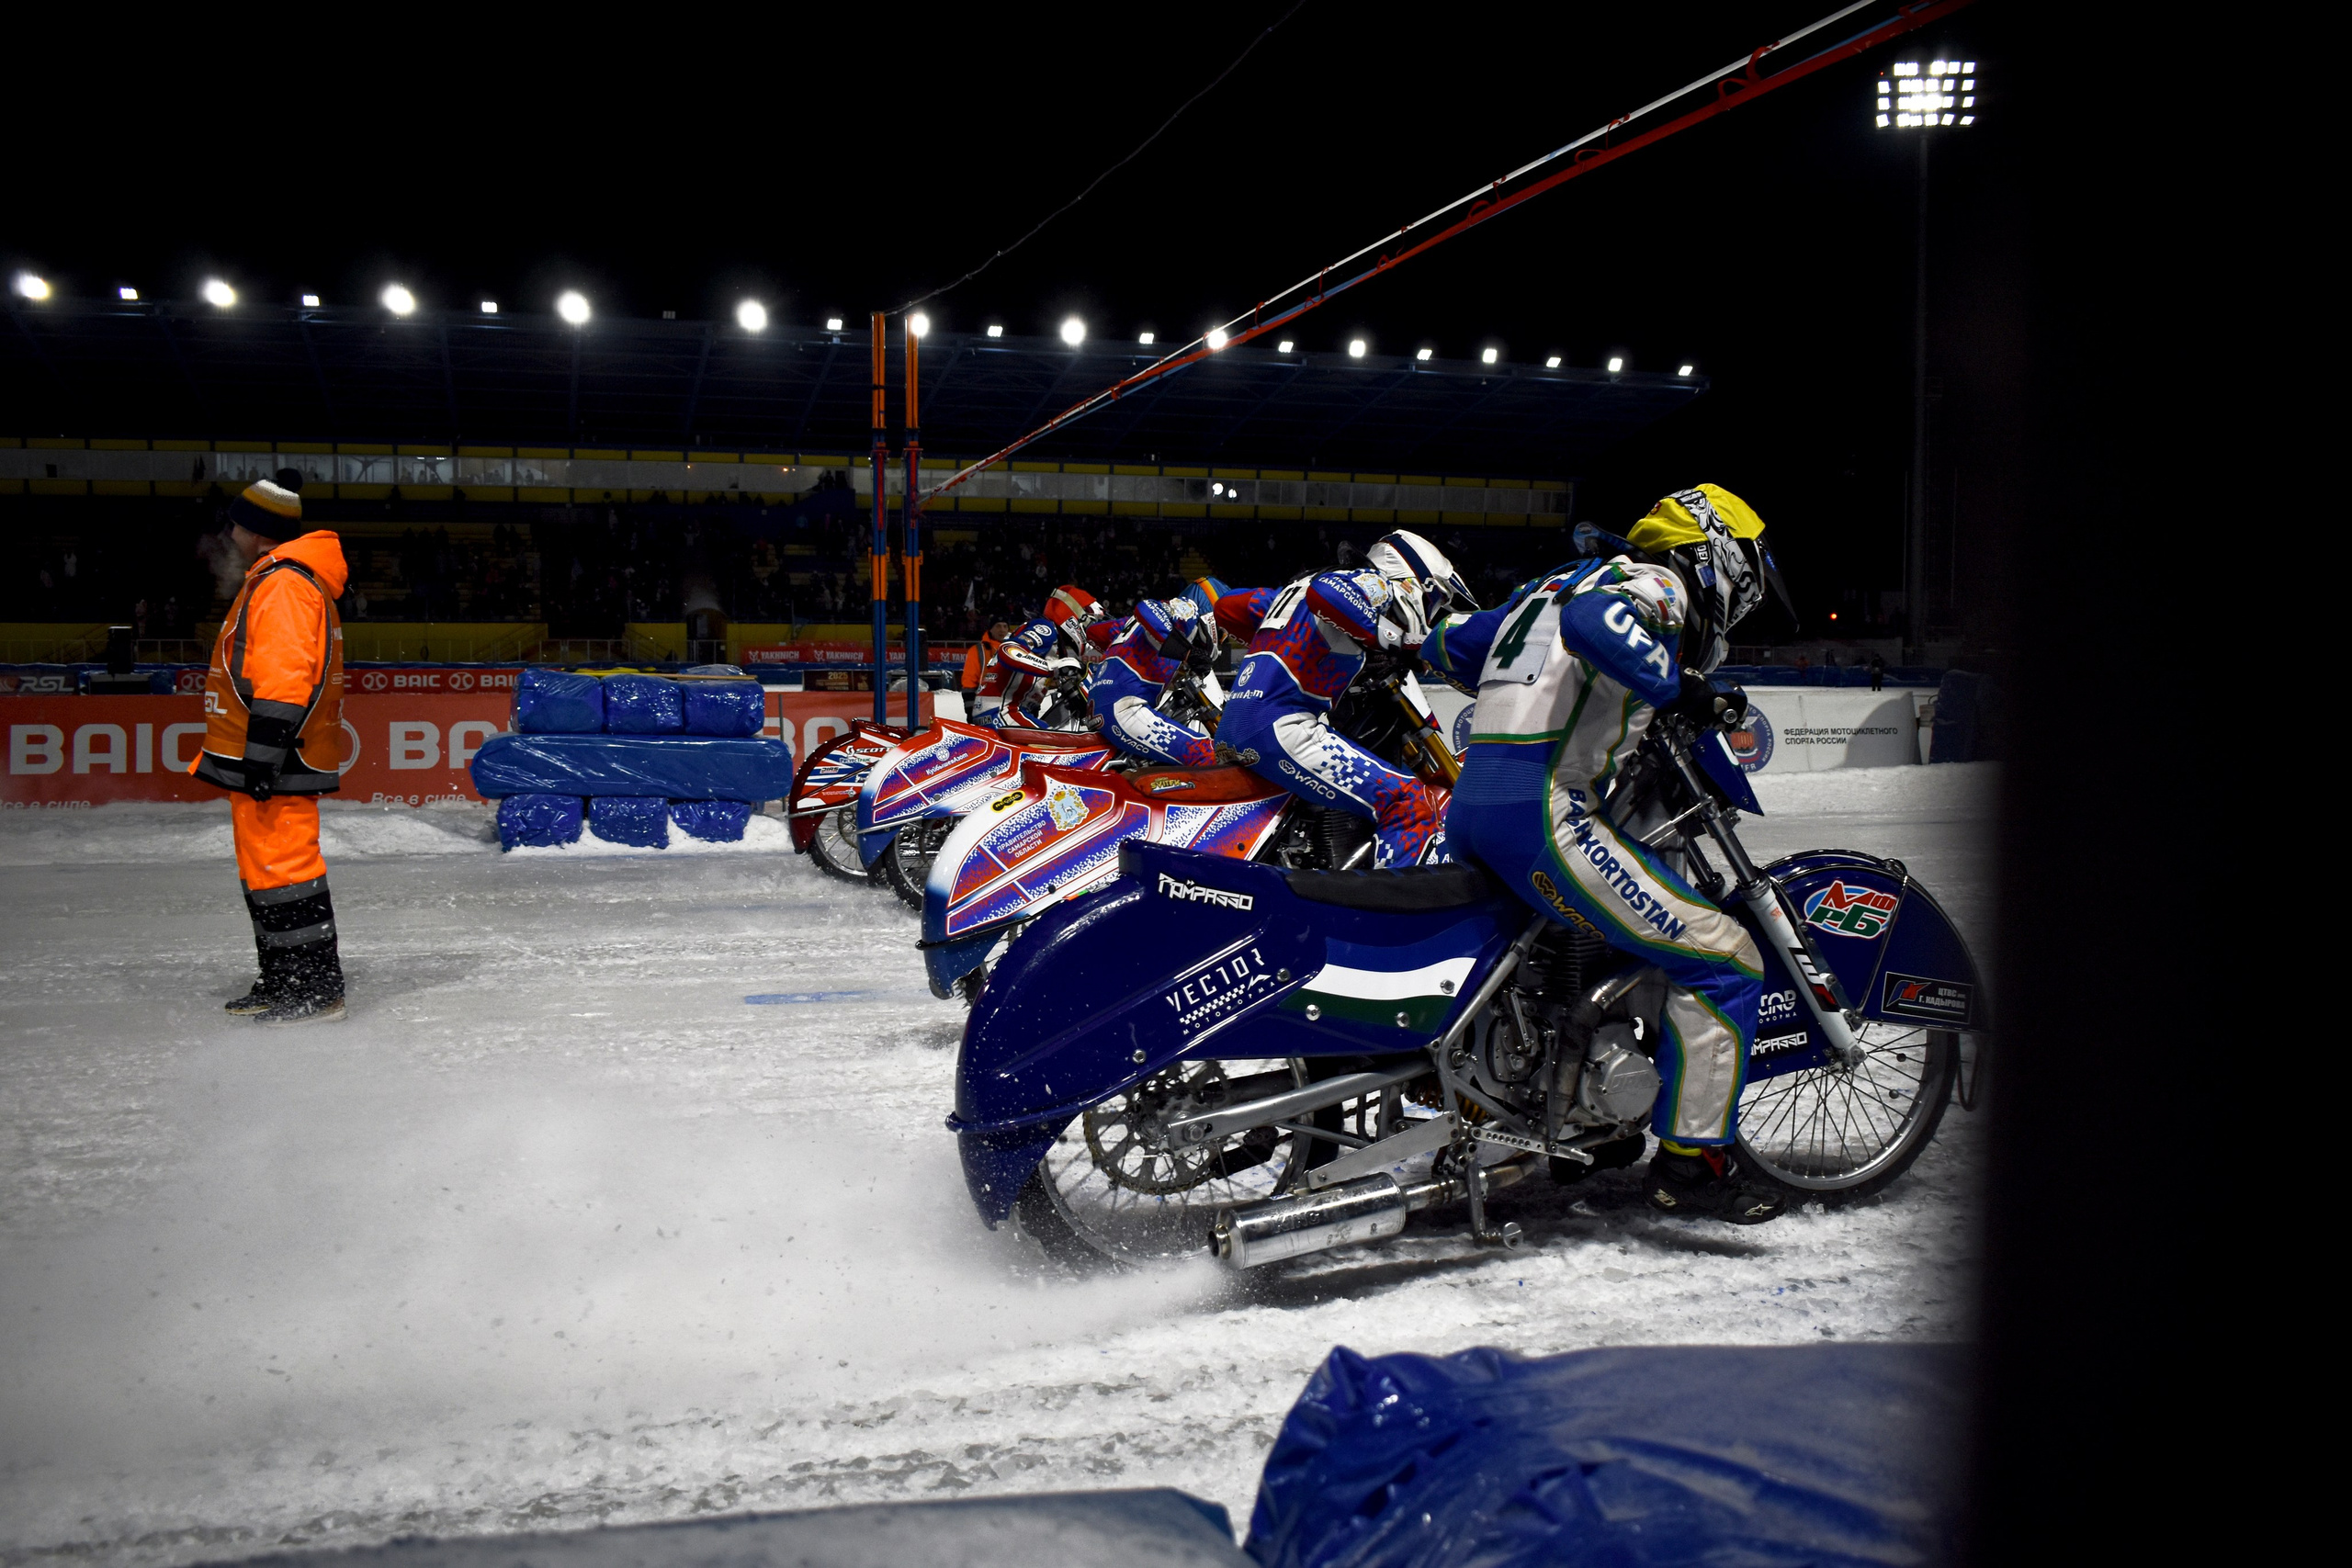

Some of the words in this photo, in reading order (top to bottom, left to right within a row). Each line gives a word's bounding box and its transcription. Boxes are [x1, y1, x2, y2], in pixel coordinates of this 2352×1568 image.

[1491, 597, 1548, 670] 4
[1602, 600, 1670, 681] UFA
[760, 650, 799, 660] YAKHNICH
[826, 650, 864, 660] YAKHNICH
[18, 675, 75, 693] RSL
[393, 674, 441, 688] BAIC
[828, 671, 848, 680] 2025
[1783, 728, 1829, 736] ФЕДЕРАЦИЯ
[1830, 727, 1898, 736] МОТОЦИКЛЕТНОГО
[1784, 737, 1815, 745] СПОРТА
[1815, 737, 1847, 745] РОССИИ
[9, 722, 209, 775] BAIC
[389, 720, 511, 771] BA
[1119, 736, 1149, 754] WACO
[1295, 770, 1337, 800] WACO
[0, 800, 22, 810] се
[371, 792, 404, 805] Все
[408, 795, 419, 805] в
[424, 794, 467, 805] силе
[997, 820, 1046, 852] ПРАВИТЕЛЬСТВО
[1007, 829, 1043, 854] САМАРСКОЙ
[1014, 839, 1043, 859] ОБЛАСТИ
[1553, 896, 1606, 940] WACO
[1166, 948, 1265, 1011] VECTOR
[1926, 996, 1965, 1009] КАДЫРОВА
[1750, 1031, 1808, 1056] MPASSO
